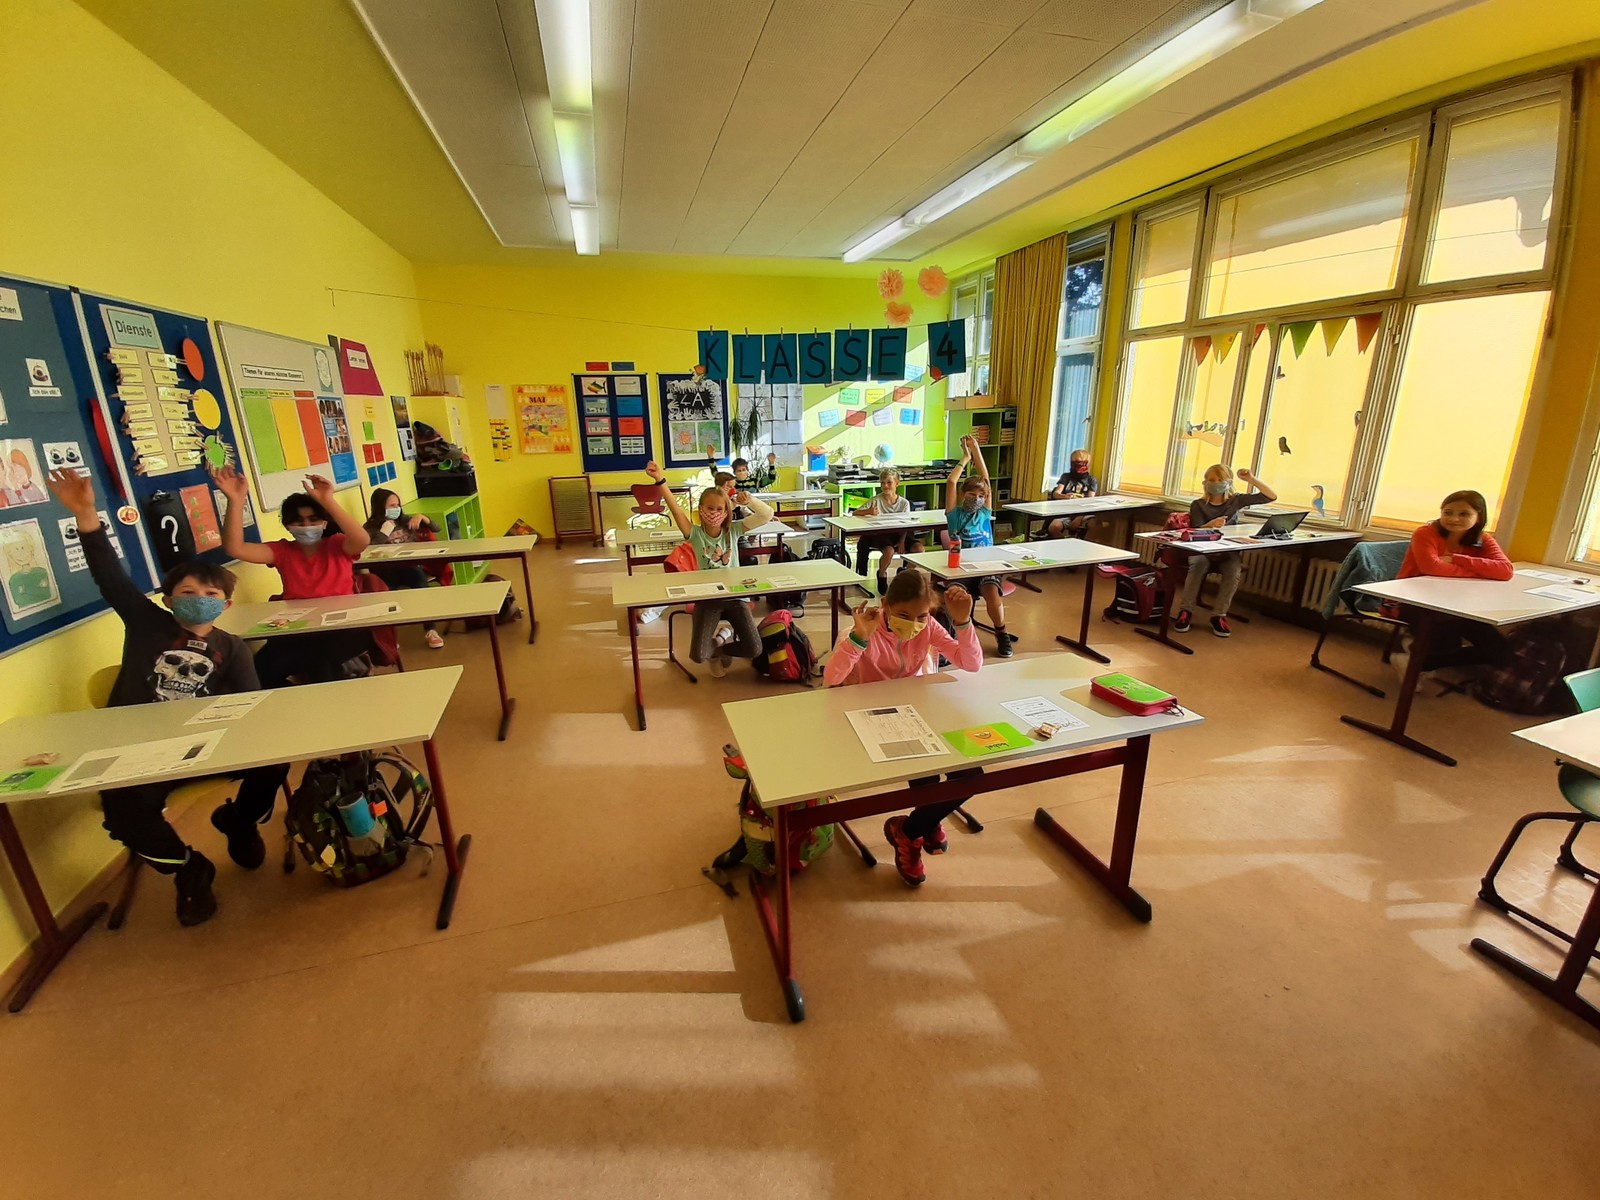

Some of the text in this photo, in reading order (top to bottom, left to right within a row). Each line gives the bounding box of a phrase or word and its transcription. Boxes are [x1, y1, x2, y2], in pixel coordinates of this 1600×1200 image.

[115, 320, 153, 338] Dienste
[704, 331, 958, 379] KLASSE 4
[529, 396, 546, 404] MAI
